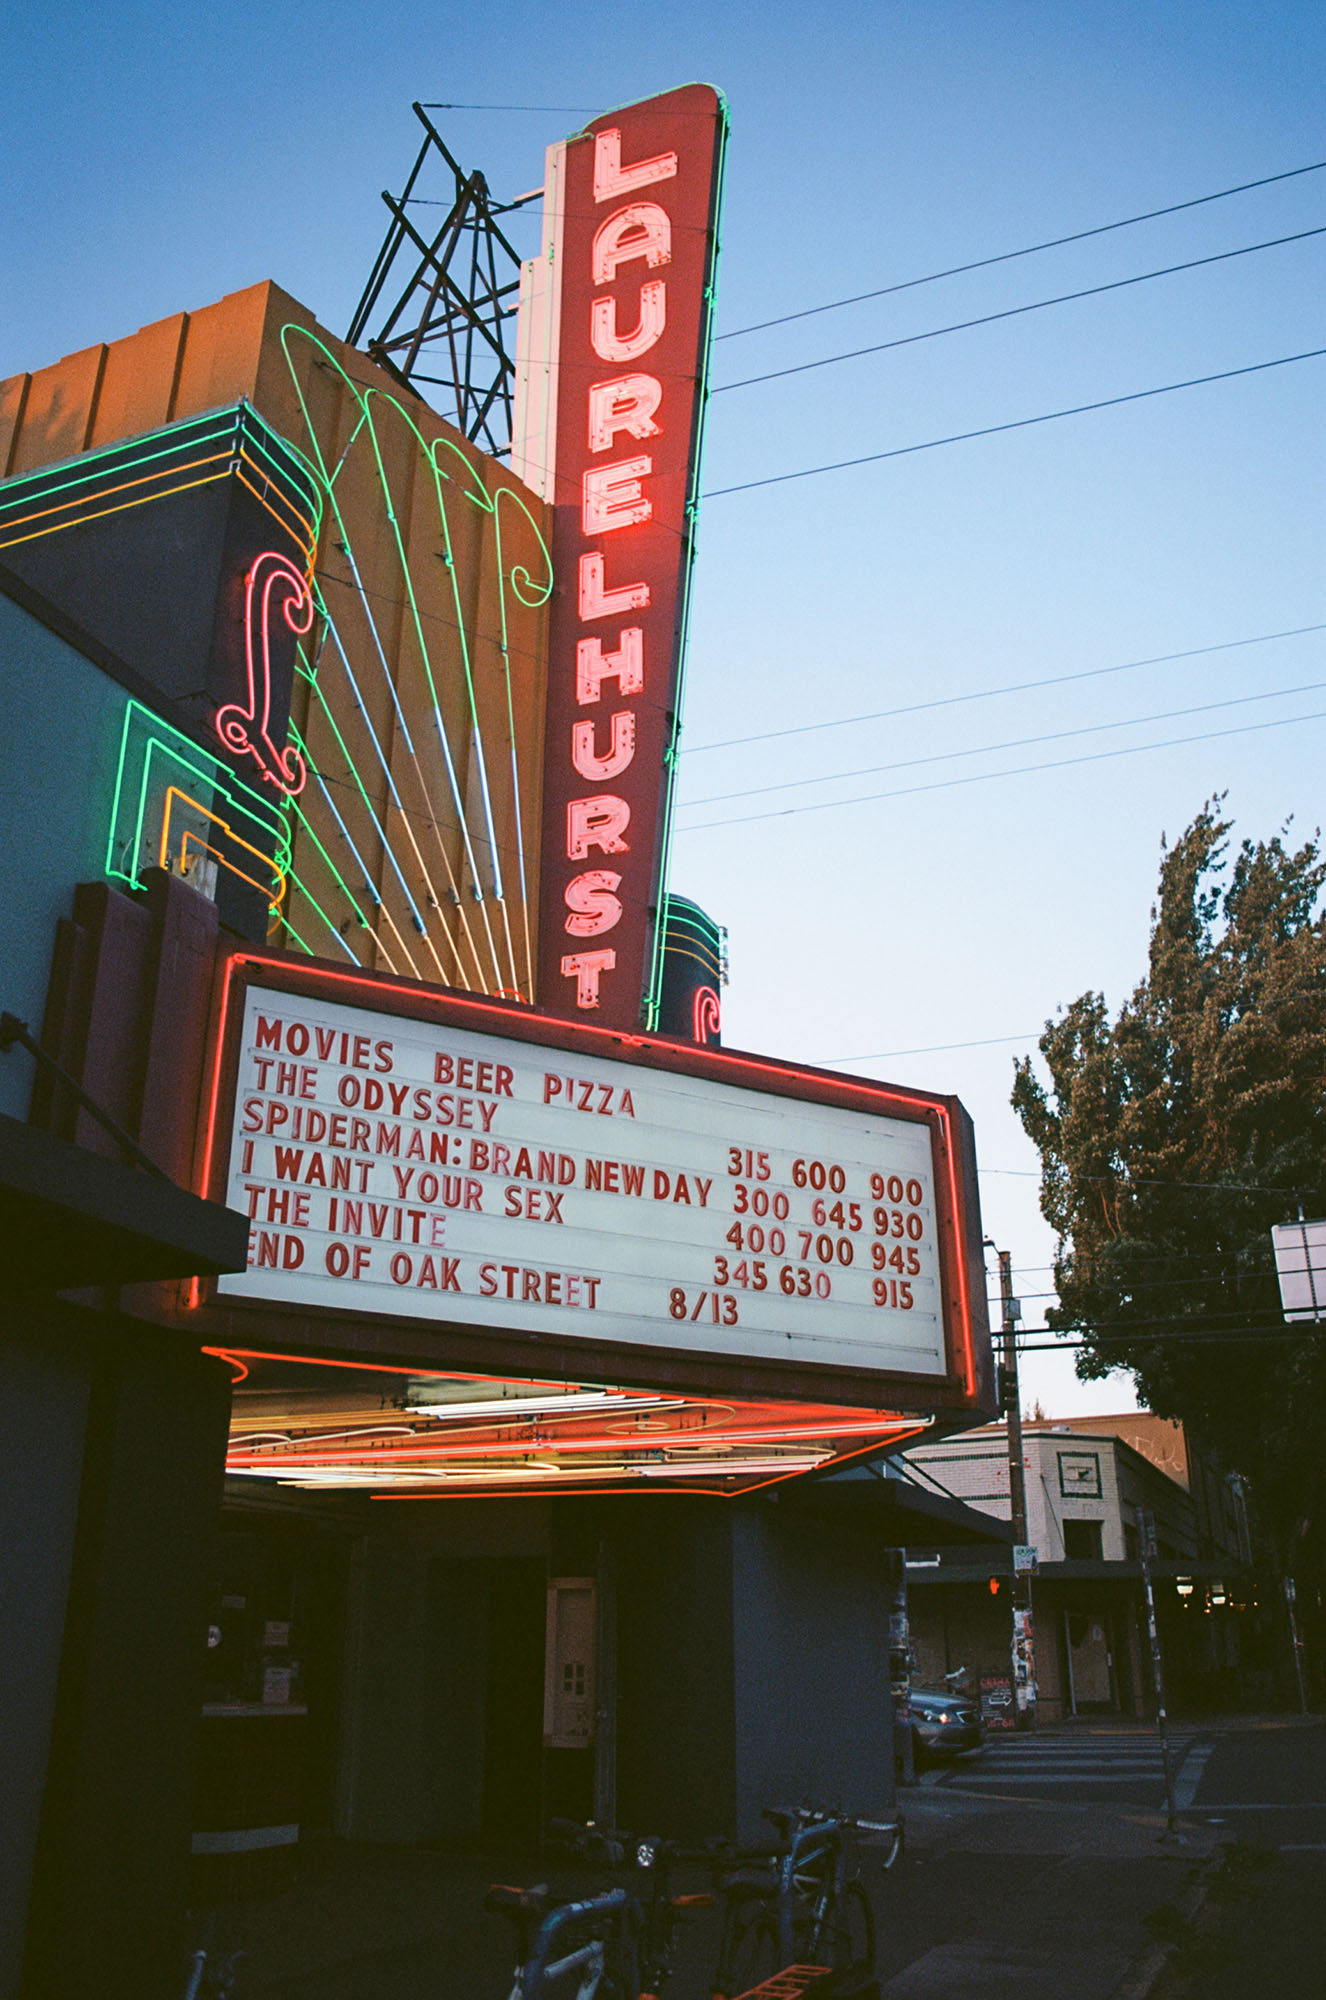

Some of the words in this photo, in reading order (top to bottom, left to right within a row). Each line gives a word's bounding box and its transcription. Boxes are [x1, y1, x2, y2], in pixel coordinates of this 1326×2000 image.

[560, 127, 678, 1009] LAURELHURST
[255, 1015, 394, 1073] MOVIES
[433, 1052, 514, 1098] BEER
[543, 1072, 636, 1118] PIZZA
[253, 1056, 319, 1101] THE
[338, 1074, 499, 1133] ODYSSEY
[727, 1146, 772, 1182] 315
[791, 1157, 847, 1195] 600
[869, 1172, 924, 1207] 900
[241, 1140, 255, 1174] I
[274, 1145, 375, 1193] WANT
[392, 1164, 484, 1212] YOUR
[504, 1184, 565, 1225] SEX
[725, 1220, 786, 1257] 400
[797, 1230, 854, 1267] 700
[870, 1241, 921, 1277] 945
[244, 1184, 312, 1228] THE
[327, 1196, 447, 1249] INVITE
[713, 1255, 769, 1292] 345
[778, 1264, 832, 1300] 630
[871, 1277, 914, 1310] 915
[585, 1158, 646, 1197] NEW
[652, 1168, 713, 1209] DAY
[732, 1183, 790, 1222] 300
[811, 1197, 864, 1233] 645
[873, 1207, 924, 1241] 930
[324, 1241, 372, 1280] OF
[389, 1251, 462, 1292] OAK
[479, 1262, 601, 1310] STREET
[669, 1287, 739, 1326] 8/13
